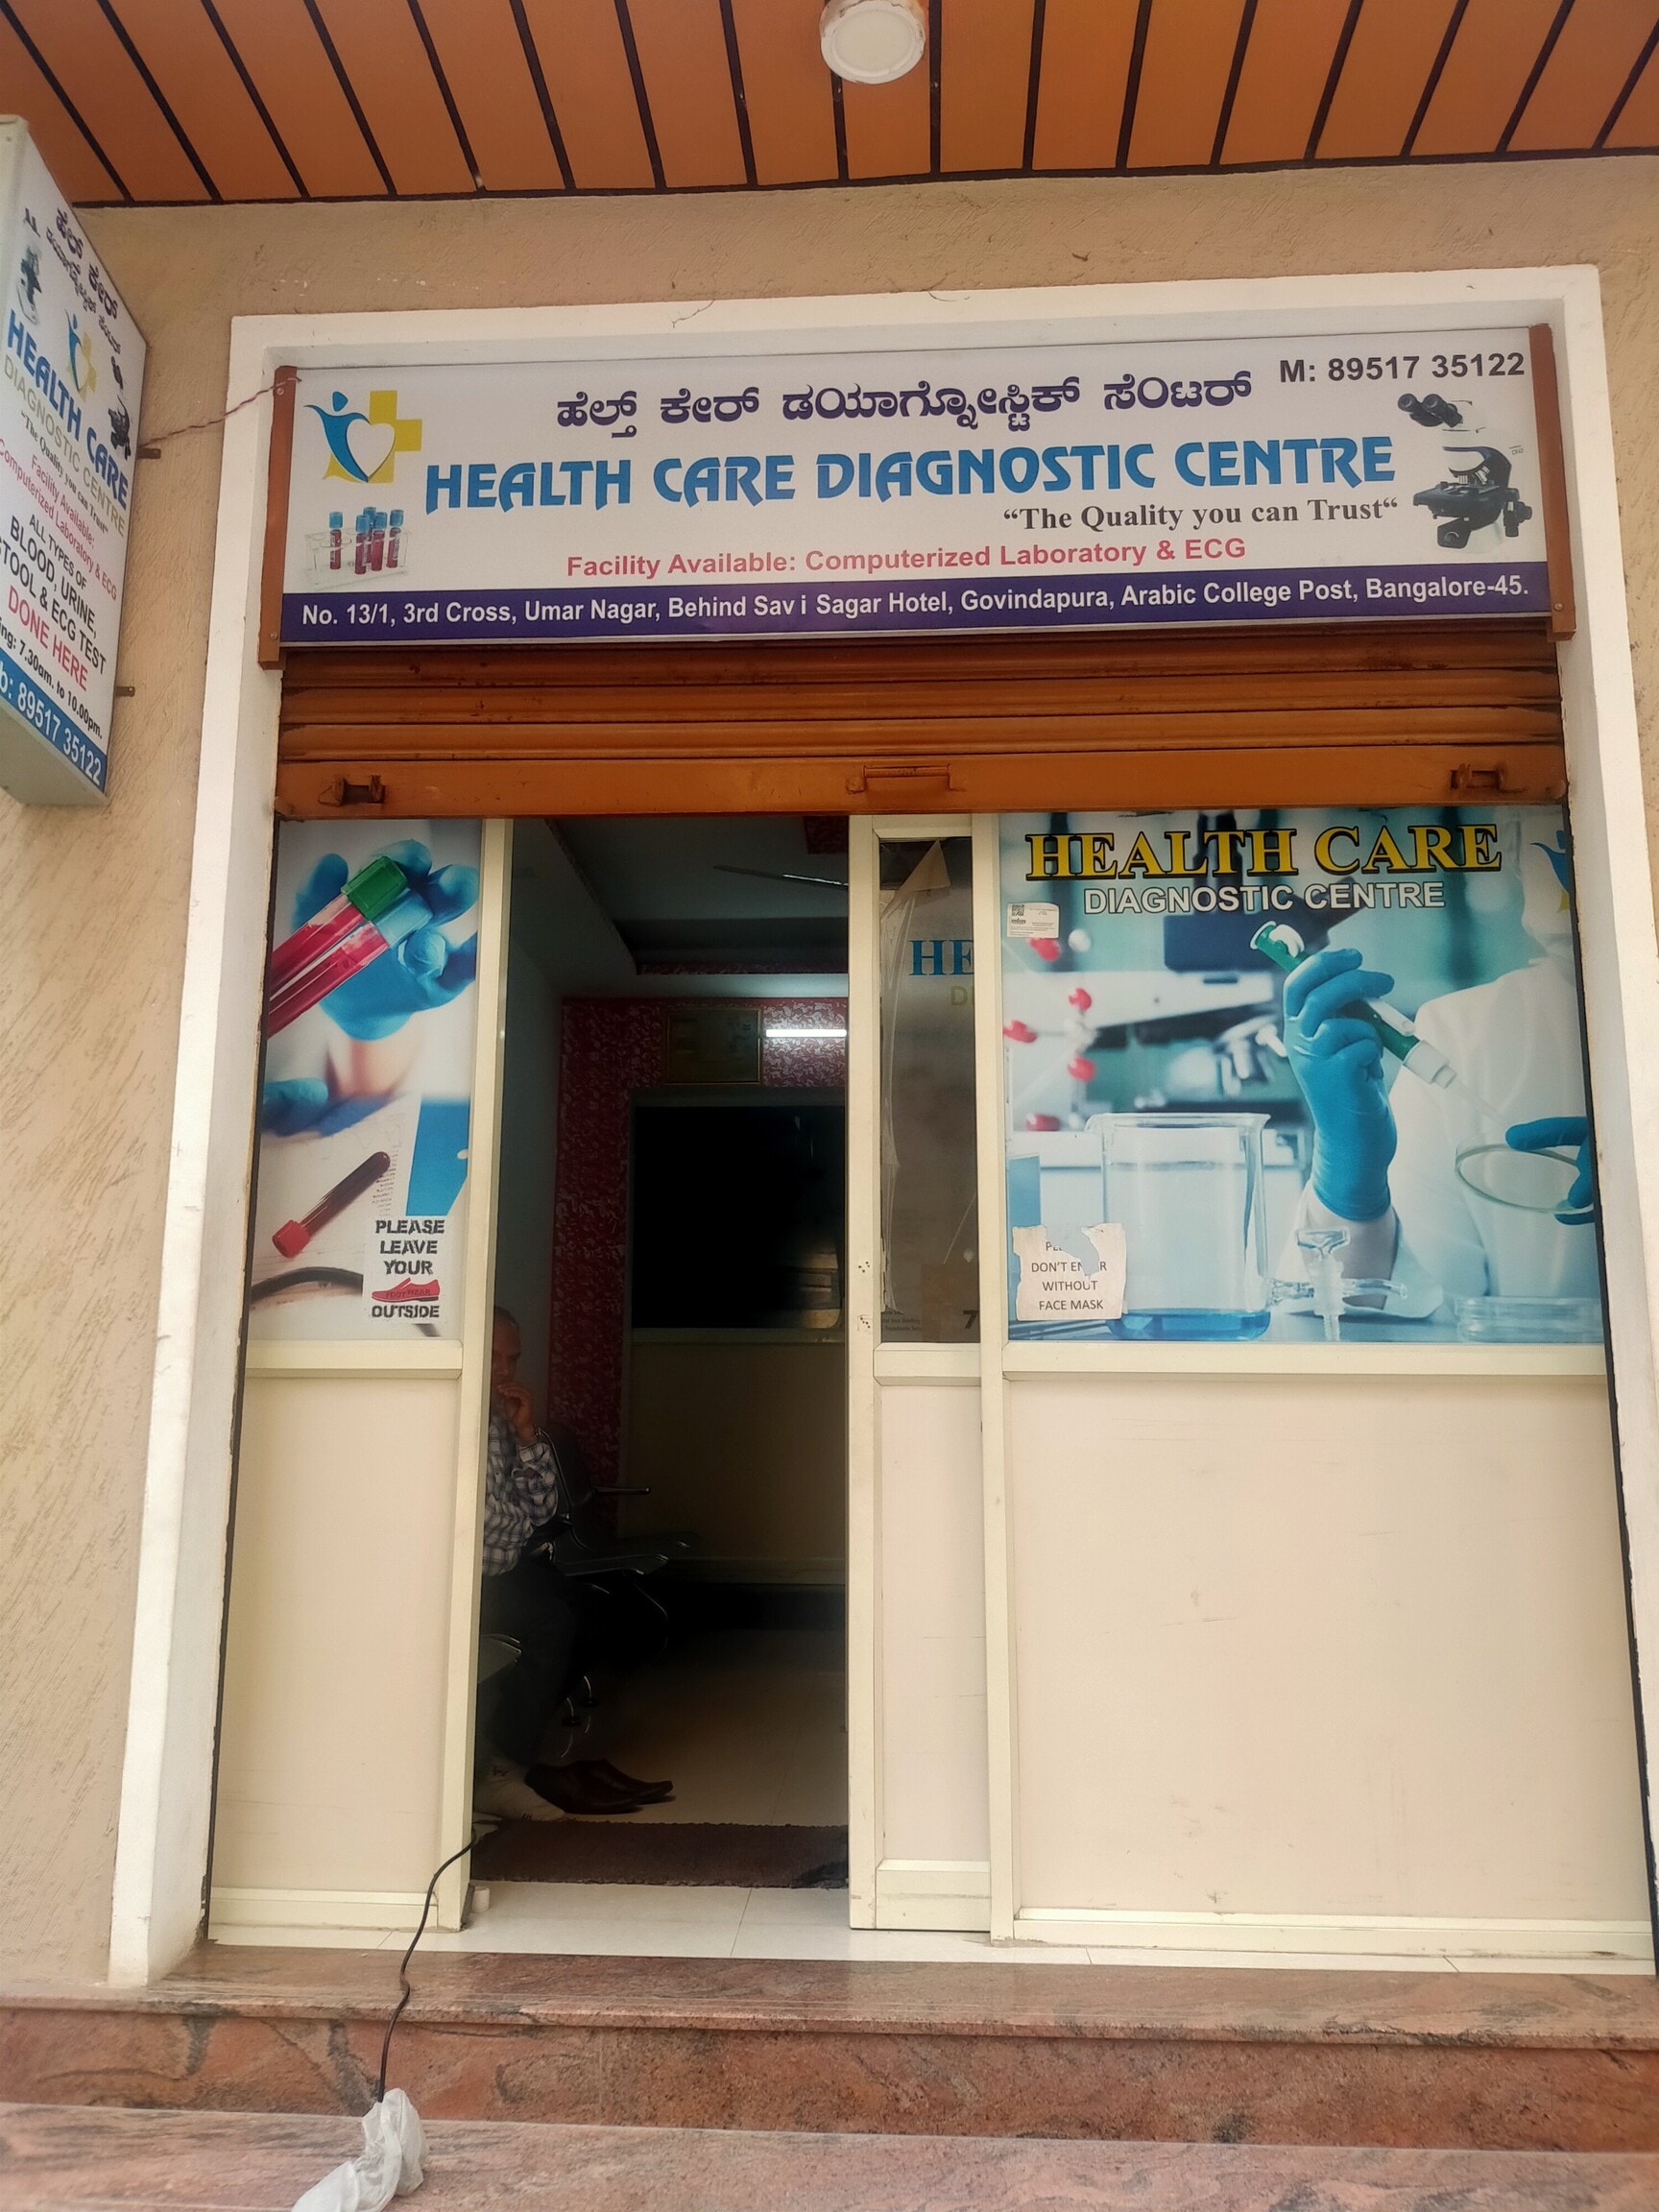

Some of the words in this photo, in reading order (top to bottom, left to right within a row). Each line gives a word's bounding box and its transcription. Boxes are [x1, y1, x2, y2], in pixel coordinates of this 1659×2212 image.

[1280, 359, 1315, 383] M:
[1328, 355, 1420, 382] 89517
[1431, 352, 1525, 378] 35122
[8, 308, 82, 442] HEALTH
[86, 427, 129, 511] CARE
[557, 390, 637, 439] ಹೆಲ್ತ್
[660, 386, 759, 424] ಕೇರ್
[1104, 370, 1252, 411] ಸೆಂಟರ್
[4, 353, 81, 472] DIAGNOSTIC
[84, 468, 125, 538] CENTRE
[39, 437, 63, 477] Quality
[64, 473, 77, 494] you
[78, 491, 88, 510] can
[426, 459, 631, 515] HEALTH
[653, 455, 796, 508] CARE
[816, 444, 1156, 502] DIAGNOSTIC
[1174, 436, 1396, 489] CENTRE
[32, 454, 60, 503] Facility
[60, 494, 94, 548] Available:
[1081, 503, 1184, 533] Quality
[1191, 506, 1242, 530] you
[1251, 504, 1299, 522] can
[11, 515, 57, 592] BLOOD,
[60, 576, 97, 639] URINE,
[29, 514, 46, 543] ALL
[49, 534, 74, 577] TYPES
[76, 570, 87, 590] OF
[56, 511, 94, 572] Laboratory
[95, 564, 101, 580] &
[102, 571, 117, 601] ECG
[567, 555, 661, 580] Facility
[667, 551, 796, 574] Available:
[805, 545, 990, 574] Computerized
[1000, 541, 1147, 566] Laboratory
[1156, 540, 1176, 561] &
[1185, 537, 1246, 560] ECG
[0, 535, 36, 599] TOOL
[40, 586, 48, 612] &
[51, 598, 76, 641] ECG
[80, 629, 107, 675] TEST
[302, 604, 338, 625] No.
[347, 603, 396, 627] 13/1,
[403, 602, 439, 623] 3rd
[445, 601, 517, 626] Cross,
[525, 600, 584, 622] Umar
[590, 598, 661, 624] Nagar,
[668, 596, 747, 618] Behind
[816, 593, 882, 619] Sagar
[889, 590, 953, 615] Hotel,
[961, 588, 1115, 613] Govindapura,
[1120, 583, 1196, 607] Arabic
[1203, 582, 1291, 607] College
[1299, 579, 1358, 603] Post,
[1365, 574, 1528, 603] Bangalore-45.
[9, 584, 50, 650] DONE
[52, 634, 88, 692] HERE
[57, 680, 65, 699] to
[17, 682, 61, 742] 89517
[62, 729, 102, 785] 35122
[1024, 826, 1299, 880] HEALTH
[1313, 823, 1503, 875] CARE
[1083, 883, 1294, 915] DIAGNOSTIC
[1303, 880, 1446, 910] CENTRE
[908, 939, 974, 976] HE
[375, 1219, 445, 1235] PLEASE
[380, 1239, 438, 1255] LEAVE
[384, 1259, 434, 1276] YOUR
[1042, 1280, 1098, 1291] WITHOUT
[1070, 1261, 1107, 1272] ENR
[372, 1305, 441, 1318] OUTSIDE
[1039, 1300, 1068, 1310] FACE
[1070, 1299, 1104, 1310] MASK
